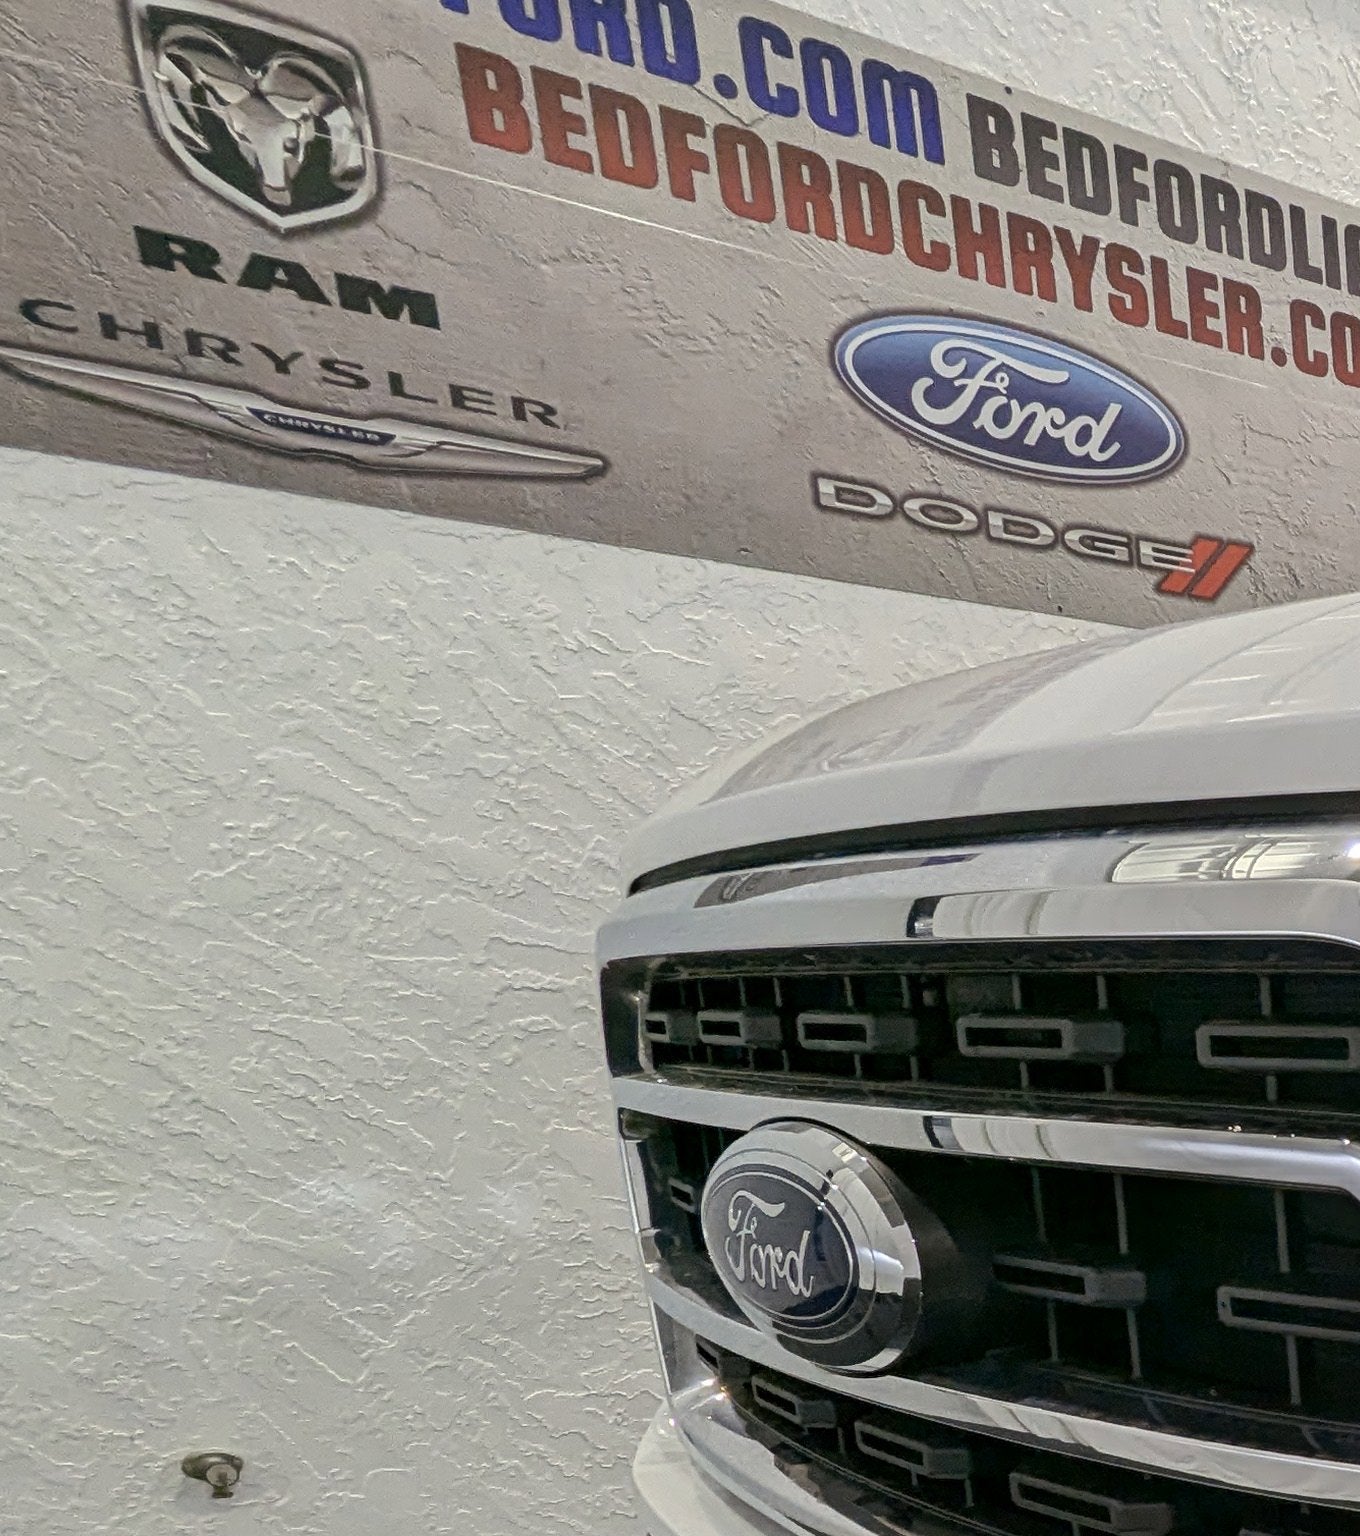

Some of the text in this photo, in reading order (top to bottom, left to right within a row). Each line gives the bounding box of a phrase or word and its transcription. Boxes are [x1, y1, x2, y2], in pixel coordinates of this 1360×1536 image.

[439, 0, 945, 166] RD.COM
[133, 226, 441, 331] RAM
[18, 298, 562, 430] CHRYSLER
[911, 337, 1122, 464] Ford
[815, 478, 1199, 573] DODGE
[725, 1190, 815, 1298] Ford
